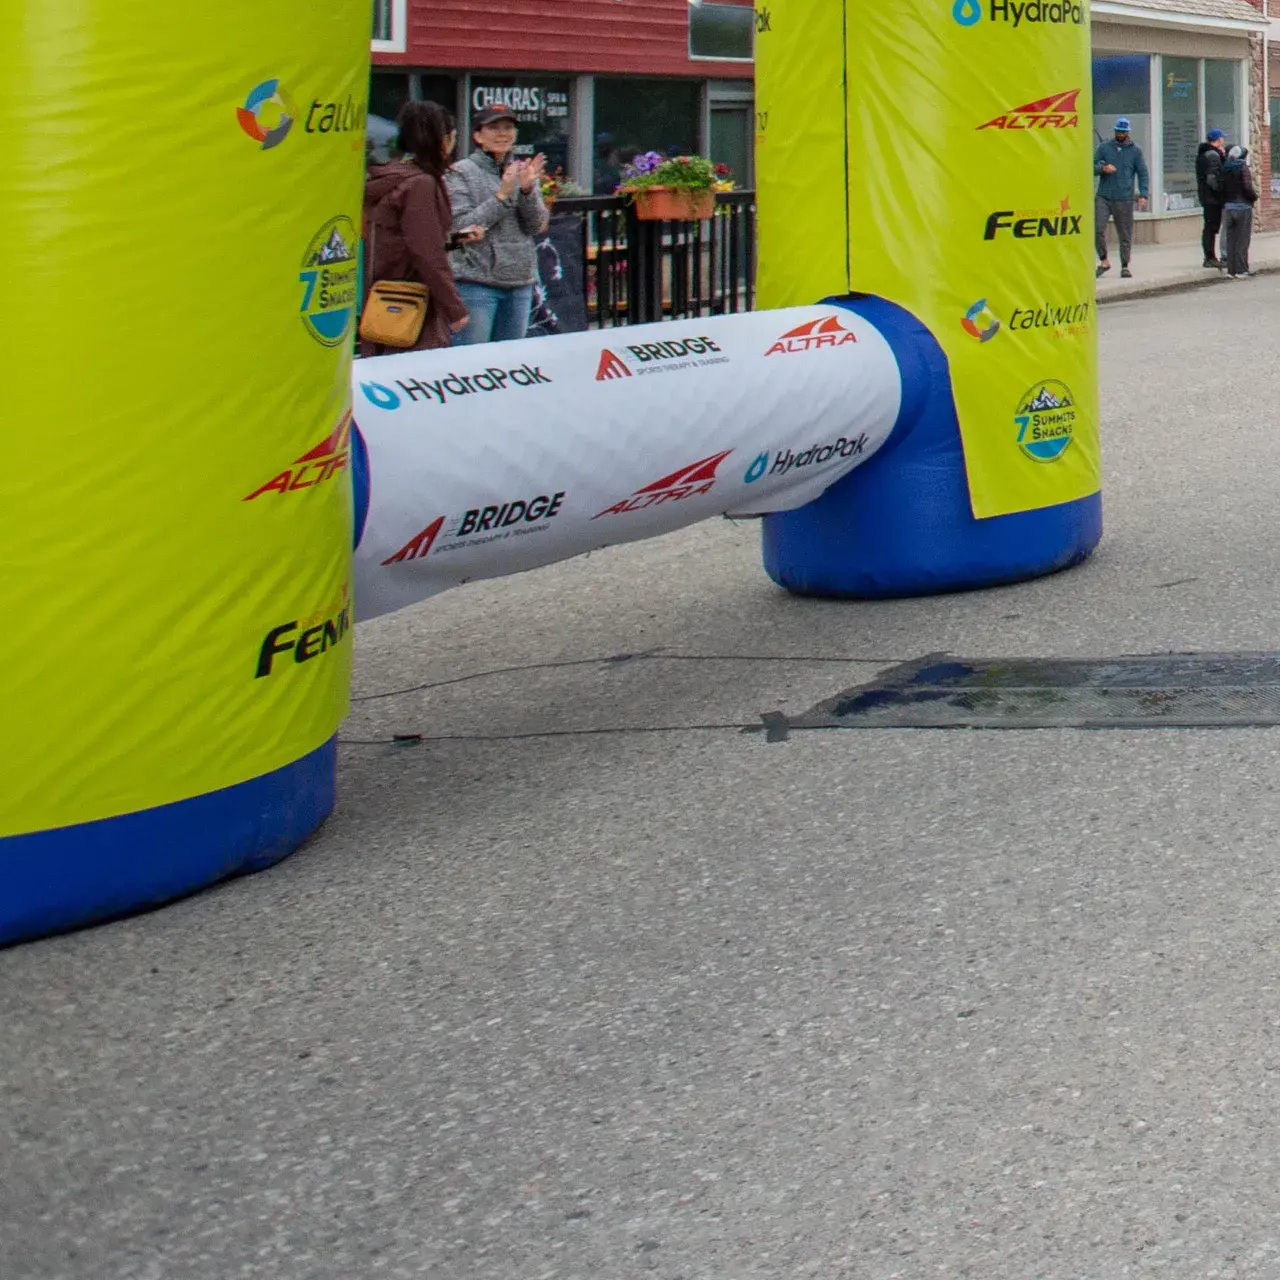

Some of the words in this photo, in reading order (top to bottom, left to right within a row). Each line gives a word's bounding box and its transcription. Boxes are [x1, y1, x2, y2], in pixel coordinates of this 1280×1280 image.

[472, 86, 539, 111] CHAKRAS
[975, 114, 1079, 130] ALTRA
[983, 210, 1083, 241] FENIX
[298, 270, 319, 313] 7
[627, 335, 721, 363] BRIDGE
[764, 332, 858, 357] ALTRA
[394, 363, 552, 404] HydraPak
[1014, 416, 1030, 442] 7
[768, 432, 869, 476] HydraPak
[456, 491, 566, 537] BRIDGE
[590, 479, 717, 521] ALTRA
